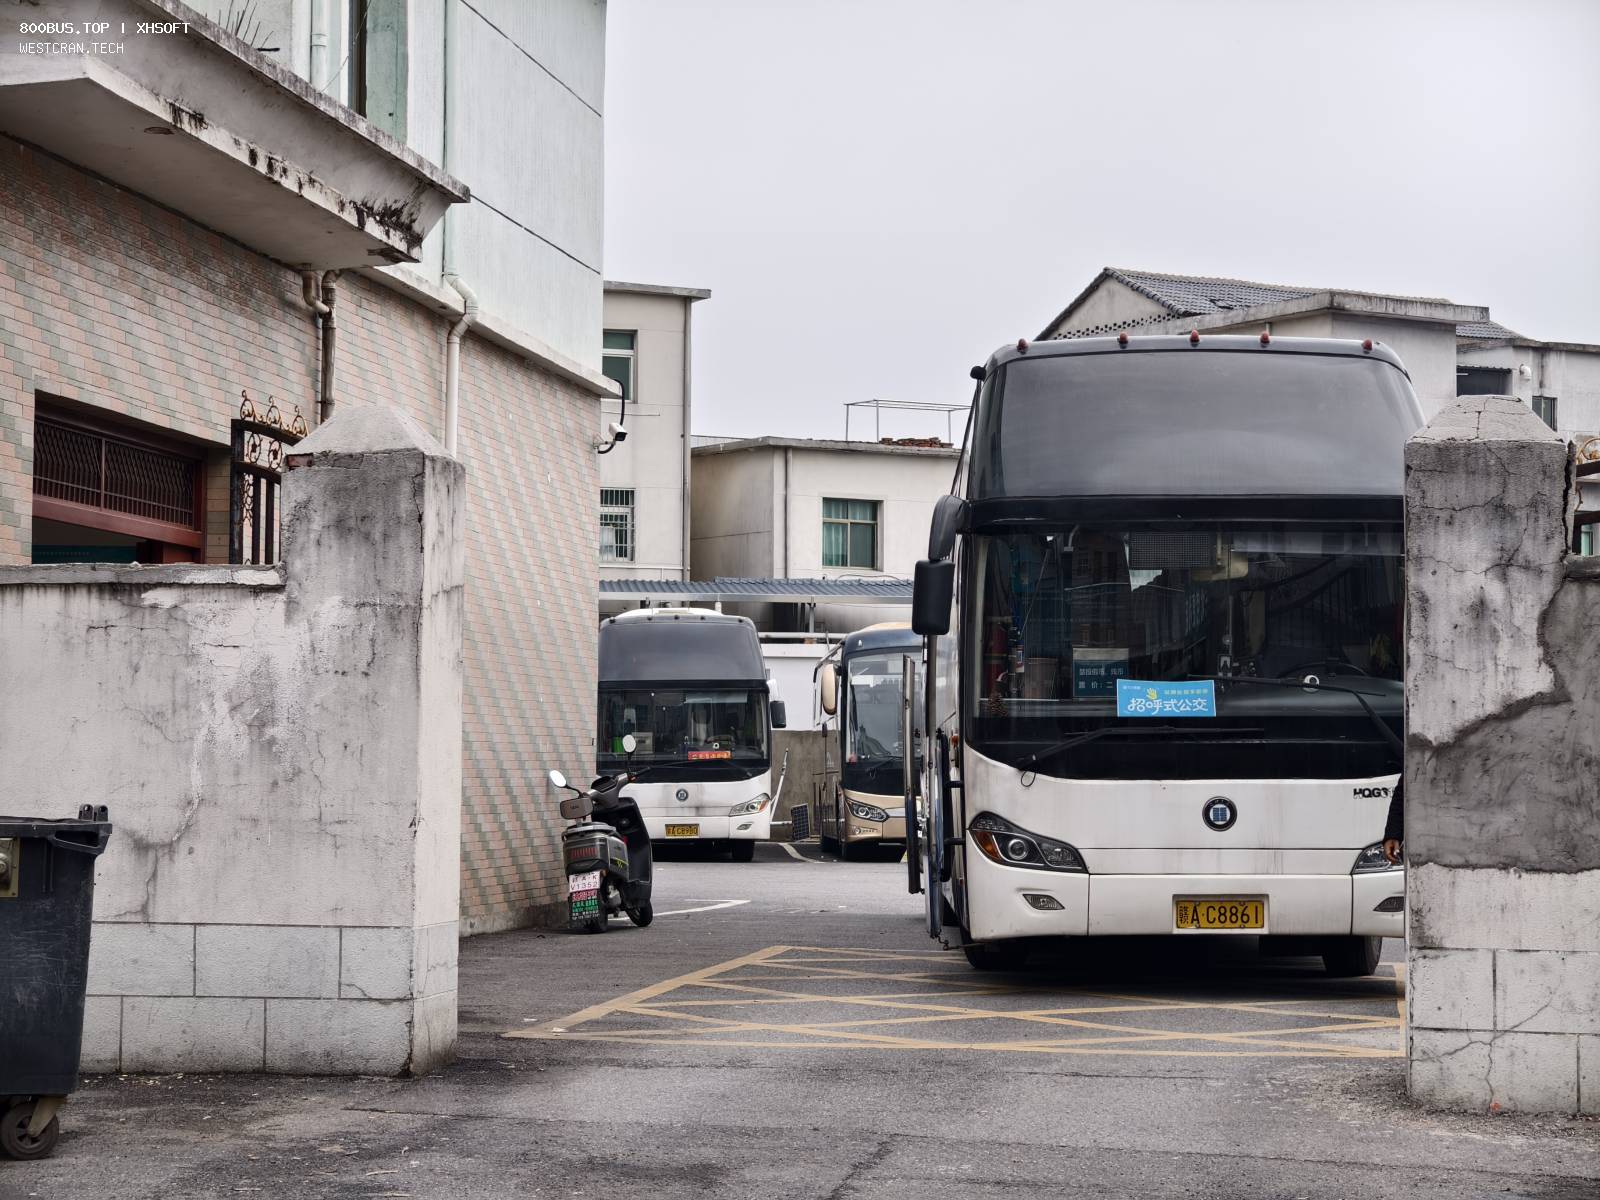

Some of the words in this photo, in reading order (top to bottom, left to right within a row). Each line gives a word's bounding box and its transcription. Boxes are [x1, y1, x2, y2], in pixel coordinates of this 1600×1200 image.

[1128, 698, 1208, 715] 招呼式公交
